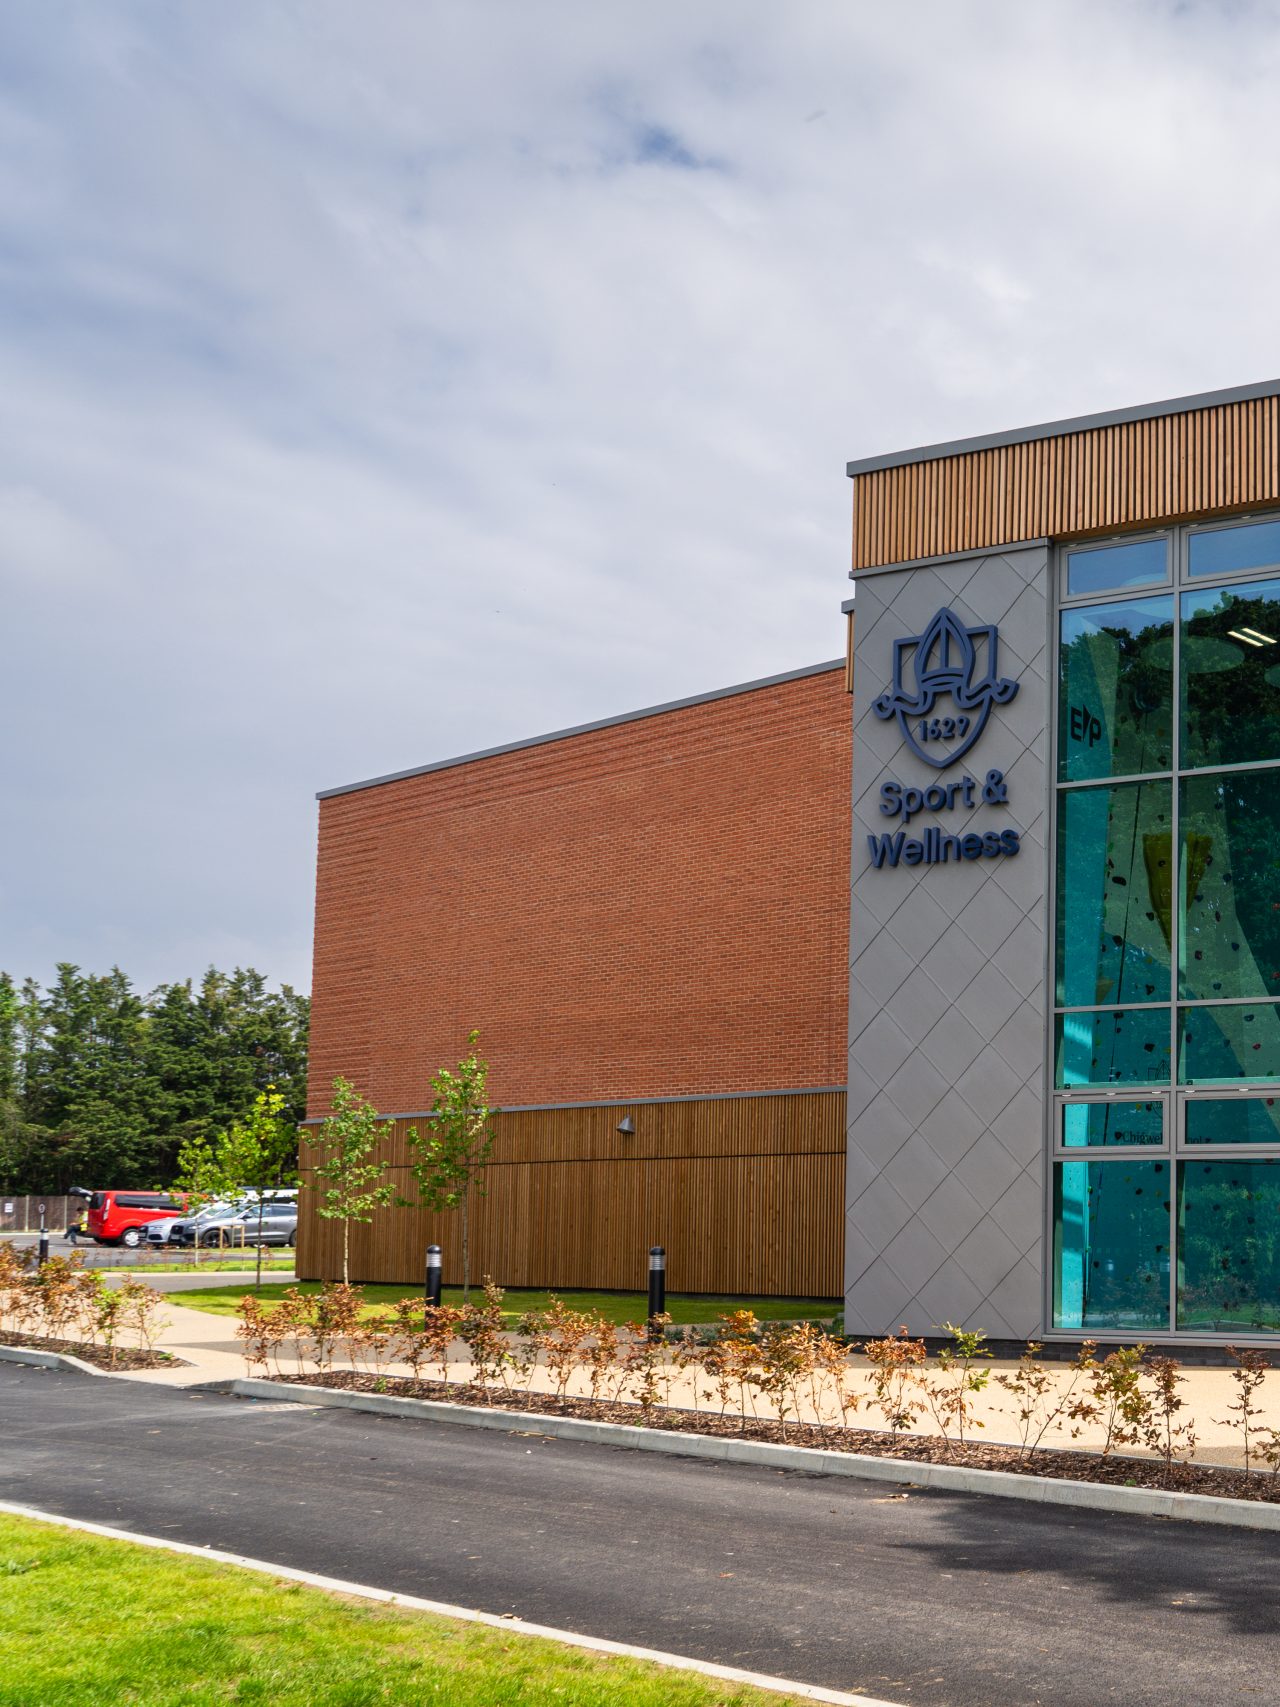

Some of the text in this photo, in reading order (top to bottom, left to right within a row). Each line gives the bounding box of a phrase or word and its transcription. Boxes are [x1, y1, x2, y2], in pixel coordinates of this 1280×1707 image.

[919, 716, 970, 741] 1629
[879, 769, 1009, 823] Sport &
[867, 826, 1020, 869] Wellness
[1122, 1131, 1163, 1145] Chigwel
